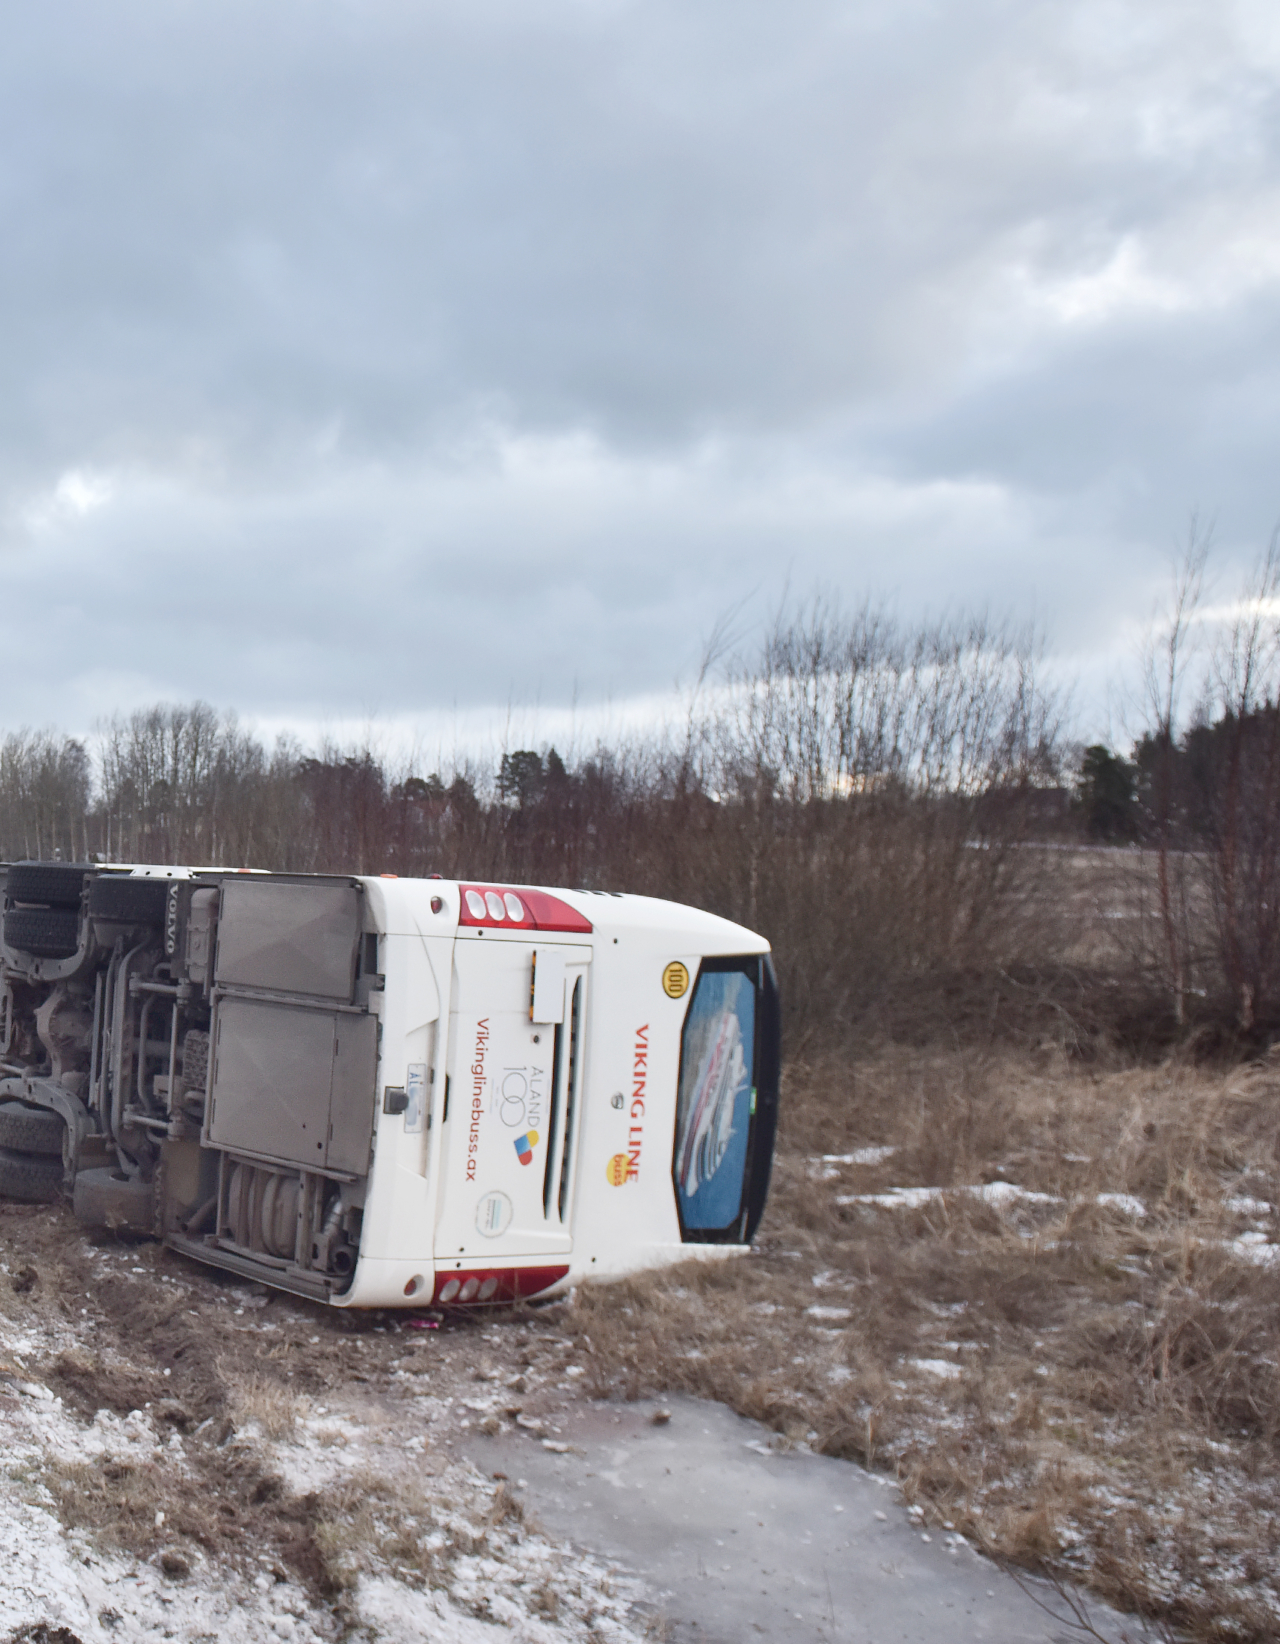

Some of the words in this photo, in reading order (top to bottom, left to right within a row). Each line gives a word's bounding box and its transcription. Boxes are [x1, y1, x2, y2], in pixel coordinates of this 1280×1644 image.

[167, 883, 179, 954] VOLVO
[669, 969, 683, 992] 100
[466, 1018, 489, 1182] Vikinglinebuss.ax
[500, 1066, 527, 1127] 100
[527, 1066, 544, 1127] ÅLAND
[630, 1023, 649, 1119] VIKING
[613, 1154, 624, 1187] buss
[625, 1127, 643, 1183] LINE
